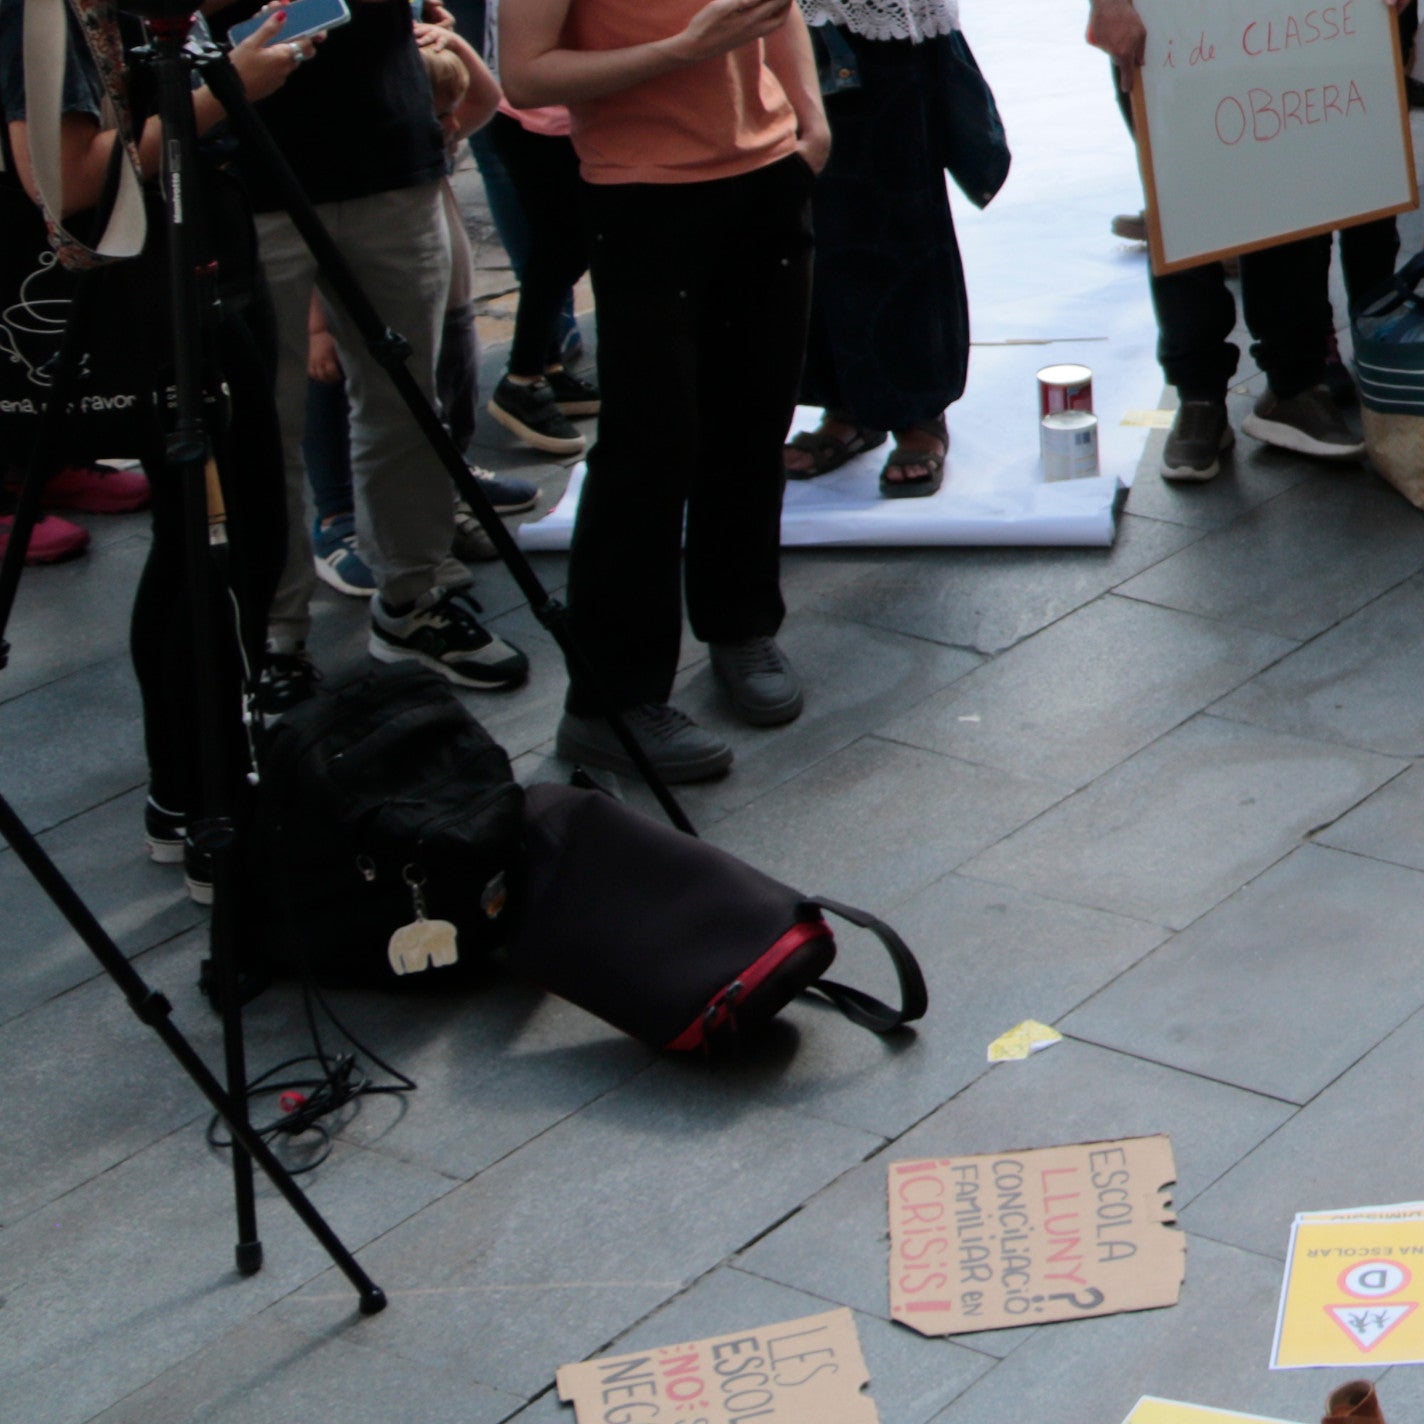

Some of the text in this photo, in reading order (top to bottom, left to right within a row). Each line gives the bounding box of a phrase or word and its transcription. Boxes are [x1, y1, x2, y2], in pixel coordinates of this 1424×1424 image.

[1189, 32, 1216, 66] de
[1242, 1, 1357, 58] CLASSE
[1214, 79, 1367, 146] OBRERA
[1089, 1147, 1138, 1263] ESCOLA
[1306, 1245, 1393, 1258] ESCOLAR
[1358, 1269, 1388, 1289] D
[659, 1352, 706, 1402] NO
[766, 1326, 839, 1387] LES
